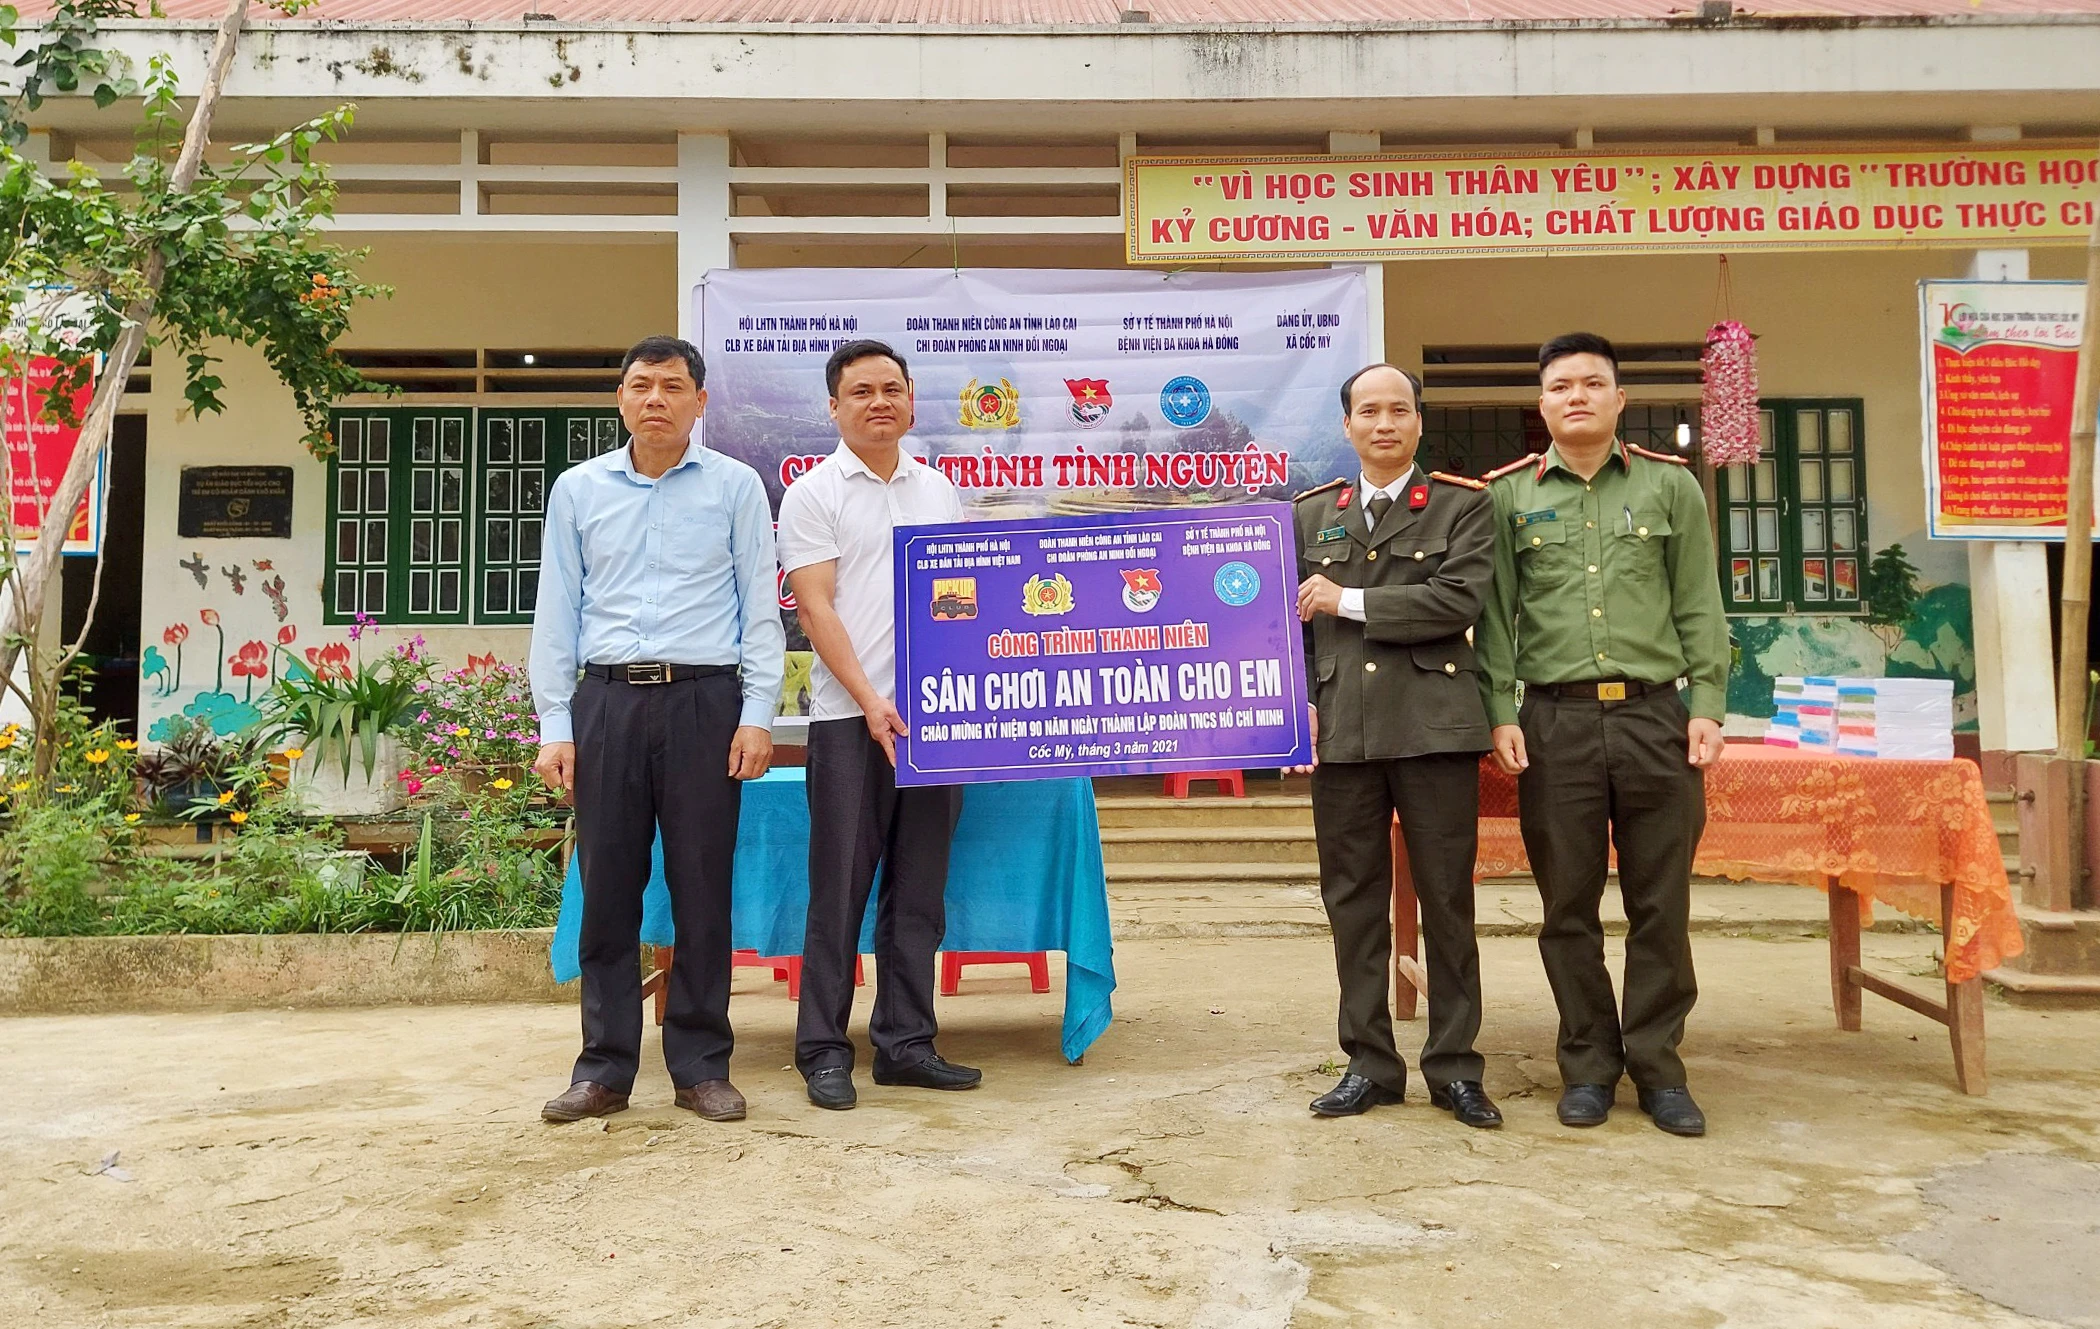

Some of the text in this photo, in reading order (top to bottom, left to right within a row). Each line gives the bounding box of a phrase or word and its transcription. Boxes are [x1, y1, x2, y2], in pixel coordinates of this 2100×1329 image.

[1265, 173, 1335, 204] HỌC
[1349, 172, 1433, 198] SINH
[1446, 164, 1538, 195] THÂN
[1673, 161, 1740, 191] XÂY
[1754, 163, 1850, 194] DỰNG
[1151, 207, 1196, 243] KỶ
[1209, 215, 1329, 242] CƯƠNG
[1367, 208, 1438, 239] VĂN
[1451, 206, 1533, 239] HÓA;
[1545, 200, 1636, 235] CHẤT
[1649, 205, 1764, 238] LƯỢNG
[1778, 201, 1860, 231] GIÁO
[1874, 204, 1943, 235] DỤC
[1955, 201, 2046, 232] THỰC
[739, 313, 858, 334] HỘI LHTN THÀNH PHỐ HÀ NỘI
[906, 313, 1077, 331] ĐOÀN THANH NIÊN CÔNG AN TỈNH LÀO CAI
[1123, 312, 1233, 332] SỞ Y TẾ THÀNH PHỐ HÀ NỘI
[1317, 314, 1340, 327] UBND
[725, 333, 849, 355] CLB XE BÁN TẢI ĐỊA HÌNH VI
[916, 334, 1068, 355] CHI ĐOÀN PHÒNG AN NINH ĐỐI NGOẠI
[1118, 334, 1239, 354] BỆNH VIỆN ĐA KHOA HÀ ĐÔNG
[1286, 333, 1297, 349] XÃ
[1299, 331, 1315, 349] CỐC
[938, 443, 1288, 492] TRÌNH TÌNH NGUYỆN
[926, 538, 1011, 556] HỘI LHTN THÀNH PHỐ HÀ NỘI
[988, 619, 1209, 657] CÔNG TRÌNH THANH NIÊN
[921, 658, 1282, 714] SÂN CHƠI AN TOÀN CHO EM
[921, 705, 1284, 742] CHÀO MỪNG KỶ NIỆM 90 NĂM NGÀY THÀNH LẬP ĐOÀN TNCS HỒ CHÍ MINH
[1028, 744, 1051, 759] Cốc
[1078, 742, 1111, 758] tháng
[1113, 742, 1121, 755] 3
[1124, 741, 1149, 754] năm
[1152, 739, 1178, 753] 2021
